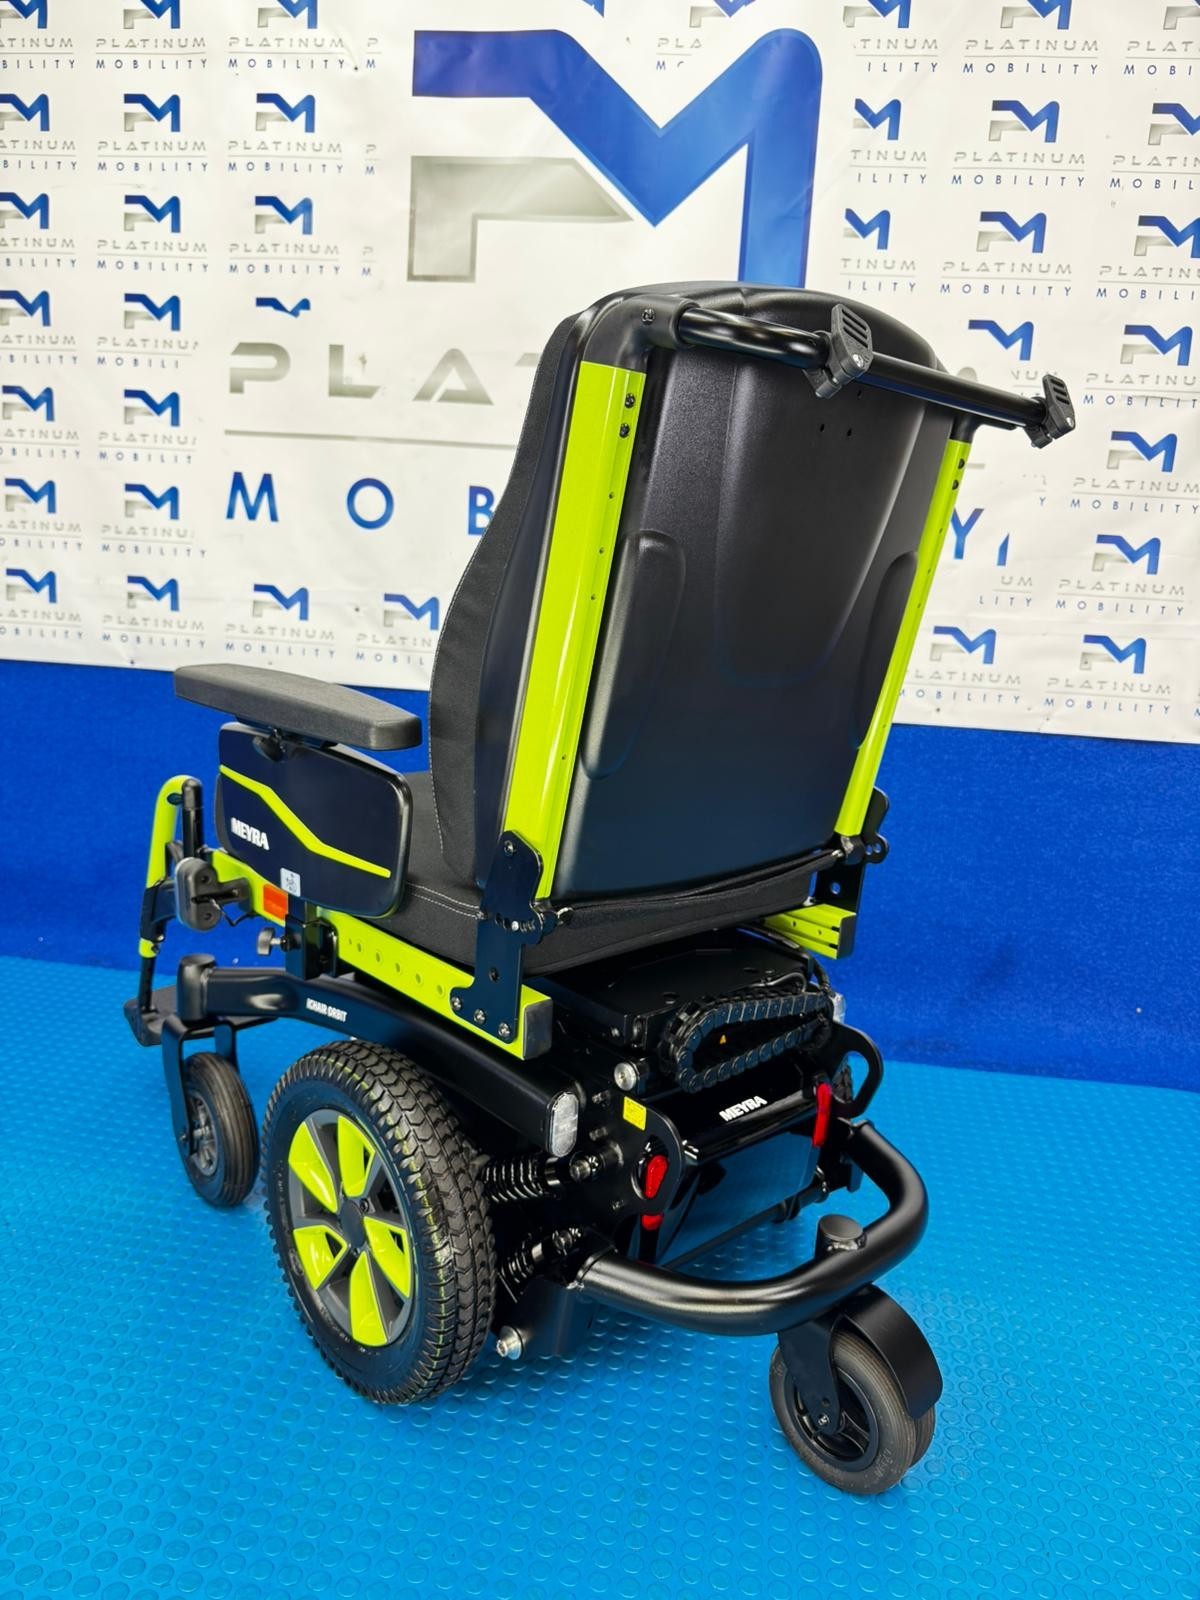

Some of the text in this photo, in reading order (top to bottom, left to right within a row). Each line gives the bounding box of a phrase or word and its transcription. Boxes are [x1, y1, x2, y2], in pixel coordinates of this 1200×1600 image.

[96, 37, 206, 49] PLATINUM
[228, 37, 345, 49] PLATINUM
[853, 38, 938, 50] TINUM
[965, 39, 1099, 51] PLATINUM
[96, 59, 207, 70] MOBILITY
[228, 59, 345, 70] MOBILITY
[963, 62, 1098, 75] MOBILITY
[98, 141, 207, 152] PLATINUM
[227, 141, 343, 154] PLATINUM
[953, 151, 1085, 165] PLATINUM
[98, 161, 208, 172] MOBILITY
[228, 161, 343, 174] MOBILITY
[951, 174, 1085, 188] MOBILITY
[97, 240, 207, 253] PLATINUM
[229, 242, 340, 255] PLATINUM
[97, 260, 208, 272] MOBILITY
[229, 264, 341, 275] MOBILITY
[942, 261, 1072, 276] PLATINUM
[940, 283, 1071, 297] MOBILITY
[0, 355, 78, 365] BILITY
[98, 432, 196, 445] PLATINU
[1073, 477, 1200, 494] PLATINUM
[1070, 499, 1199, 515] MOBILITY
[0, 520, 82, 533] ATINUM
[101, 524, 195, 538] PLATINU
[102, 544, 206, 558] MOBILITY
[1058, 579, 1185, 596] PLATINUM
[1056, 600, 1183, 616] MOBILITY
[0, 609, 81, 622] ATINUM
[103, 614, 205, 631] PLATINUM
[225, 624, 335, 641] PLATINUM
[102, 633, 206, 648] MOBILITY
[225, 643, 336, 659] MOBILITY
[1047, 677, 1171, 695] PLATINUM
[1044, 697, 1170, 714] MOBILITY
[231, 816, 270, 851] MEYRA
[718, 1095, 768, 1122] MEYRA
